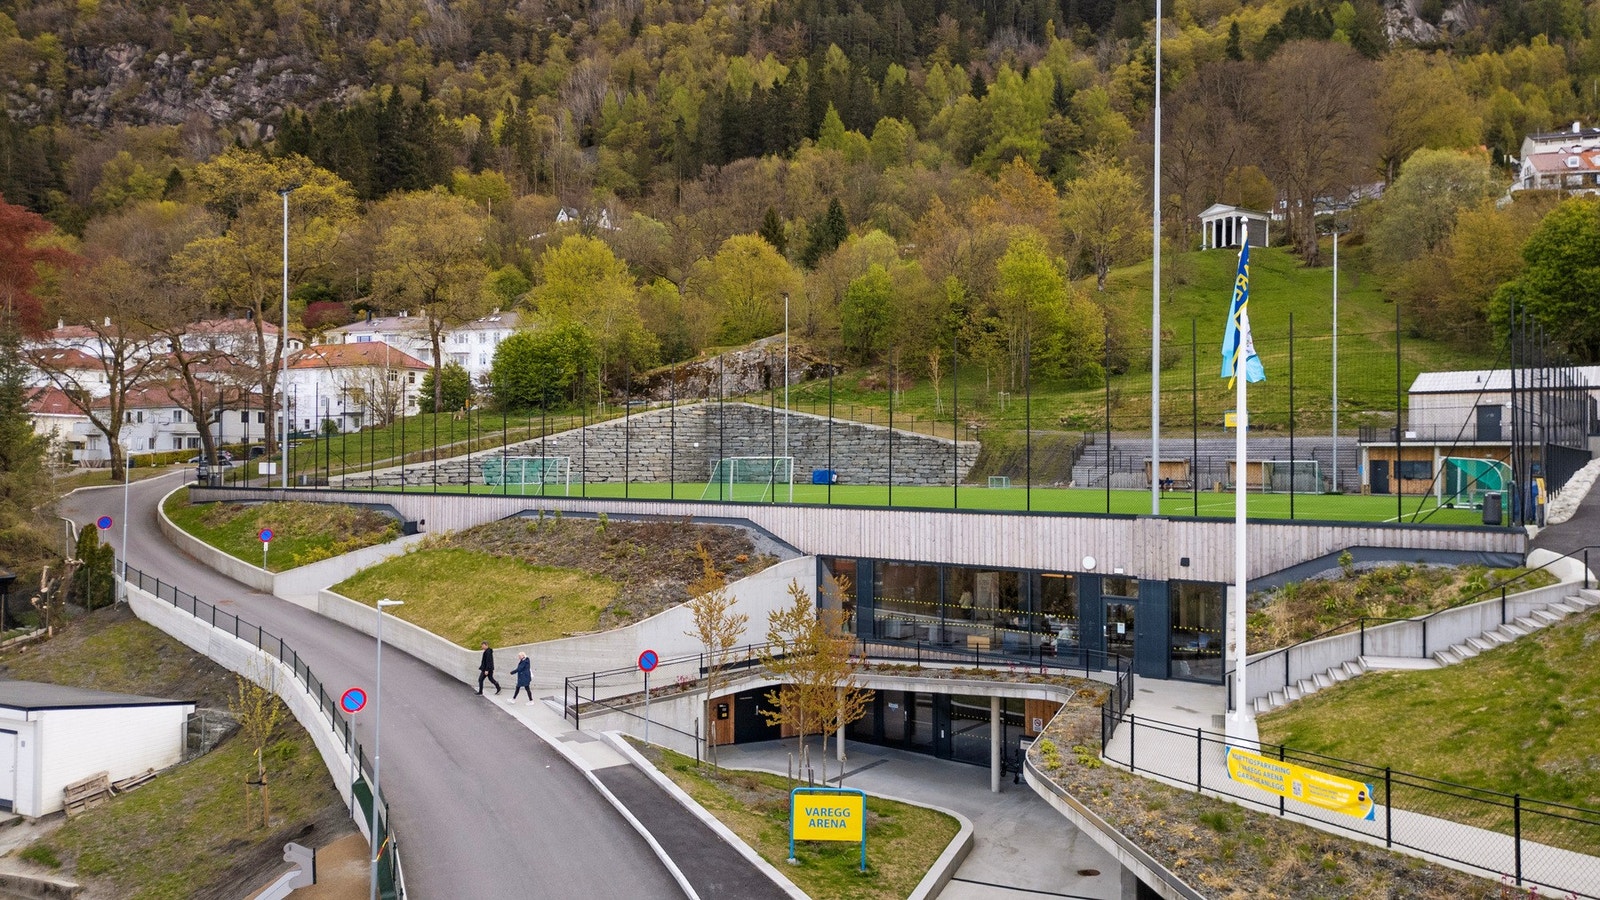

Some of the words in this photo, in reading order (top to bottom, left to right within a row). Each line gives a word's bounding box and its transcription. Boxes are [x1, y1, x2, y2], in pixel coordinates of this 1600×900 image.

[1242, 764, 1262, 777] VAREGG
[1263, 771, 1283, 781] ARENA
[805, 807, 851, 818] VAREGG
[808, 818, 847, 829] ARENA
